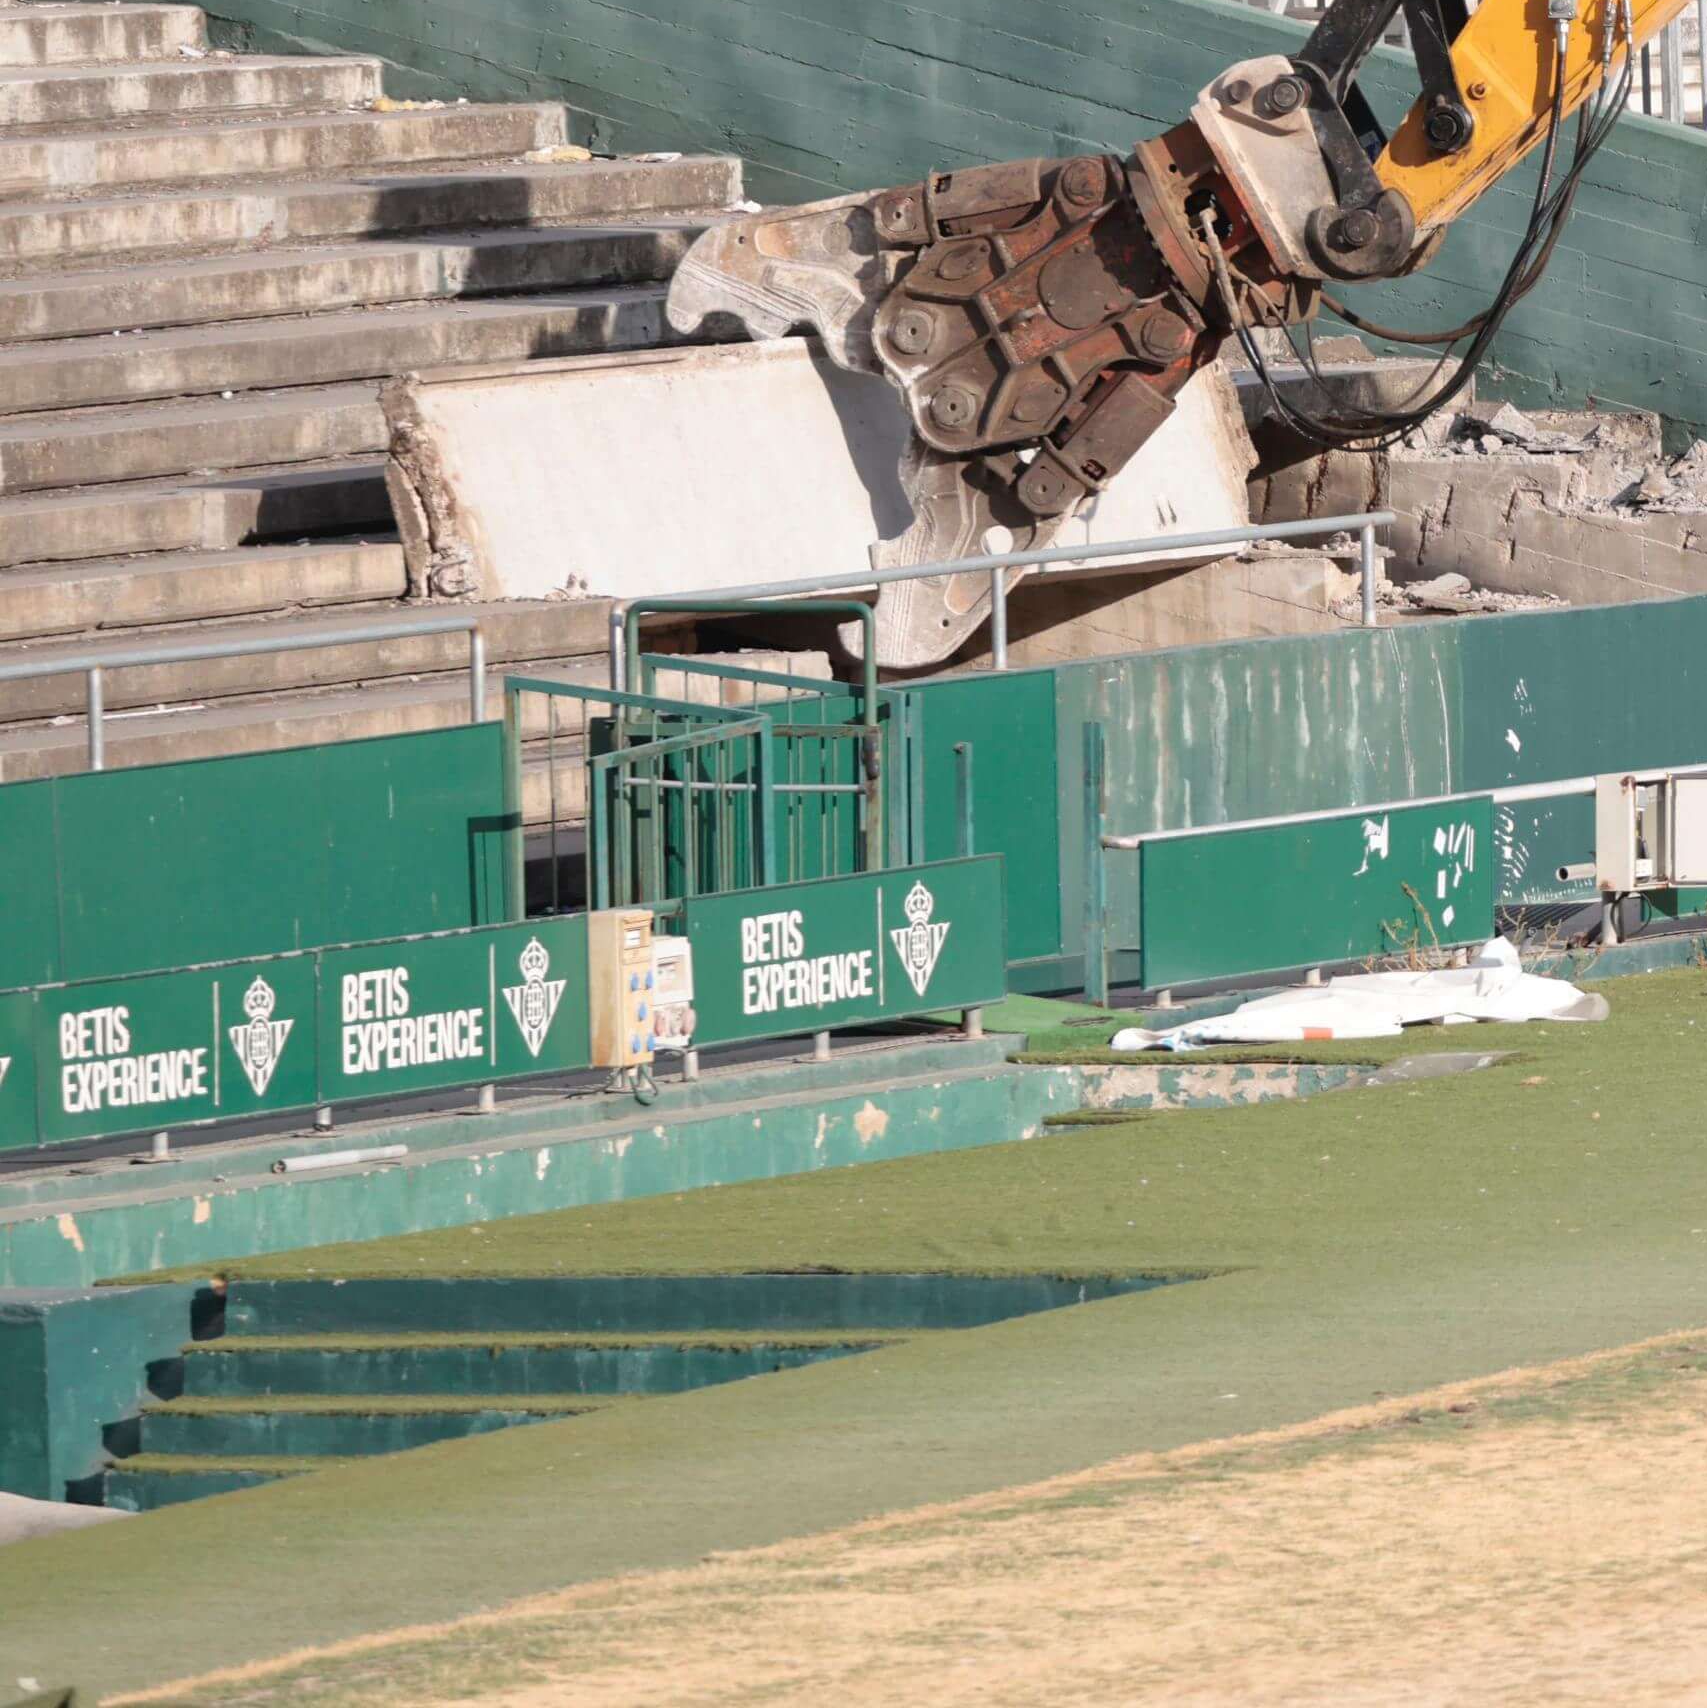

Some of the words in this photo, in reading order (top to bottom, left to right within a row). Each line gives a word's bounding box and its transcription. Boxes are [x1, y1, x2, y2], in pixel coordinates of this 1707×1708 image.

[741, 909, 804, 963] BETIS
[342, 966, 409, 1023] BETIS
[742, 949, 873, 1015] EXPERIENCE
[60, 1005, 130, 1060] BETIS
[342, 1008, 484, 1075] EXPERIENCE
[62, 1047, 209, 1113] EXPERIENCE
